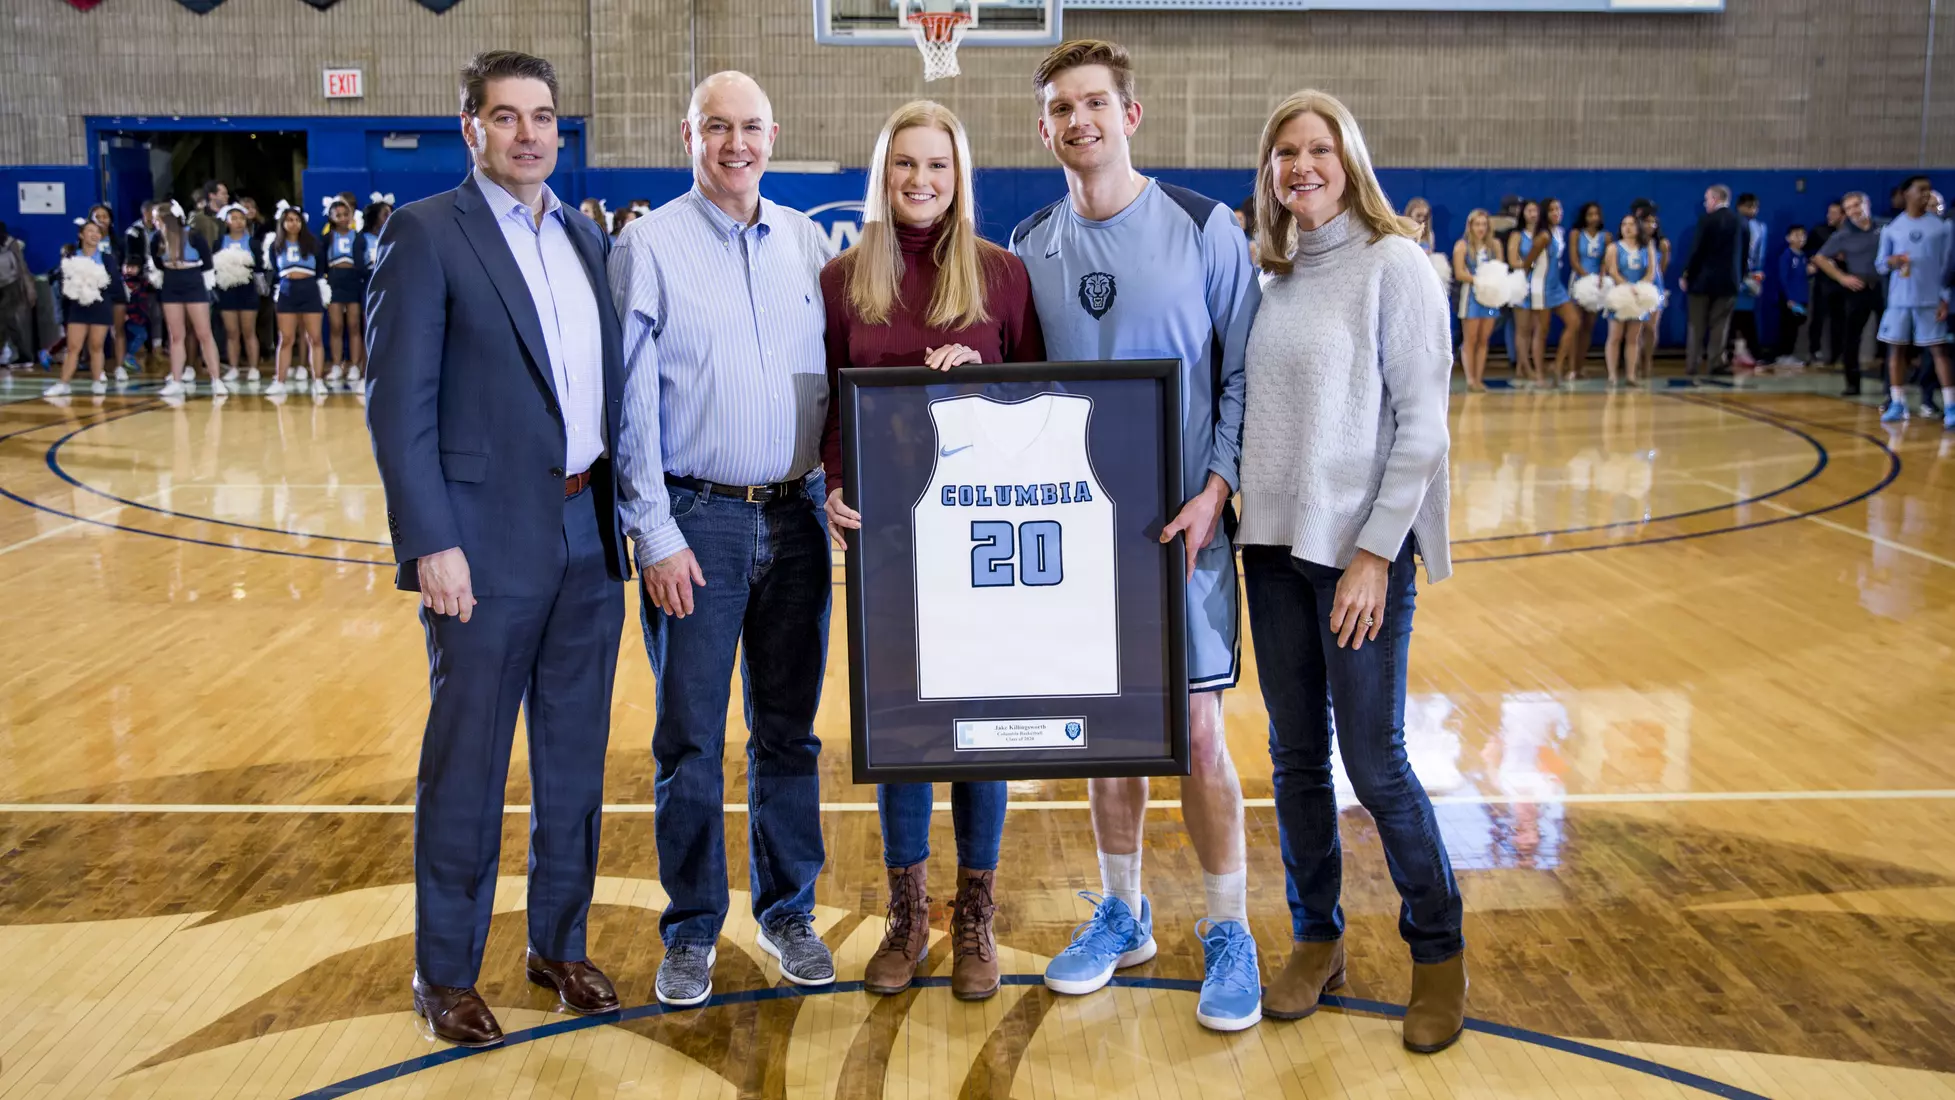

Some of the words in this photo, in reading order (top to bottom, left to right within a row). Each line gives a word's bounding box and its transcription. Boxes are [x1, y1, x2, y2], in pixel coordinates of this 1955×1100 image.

[329, 74, 357, 95] EXIT
[287, 246, 300, 262] C
[338, 237, 350, 253] C
[941, 481, 1092, 506] COLUMBIA
[971, 520, 1063, 588] 20
